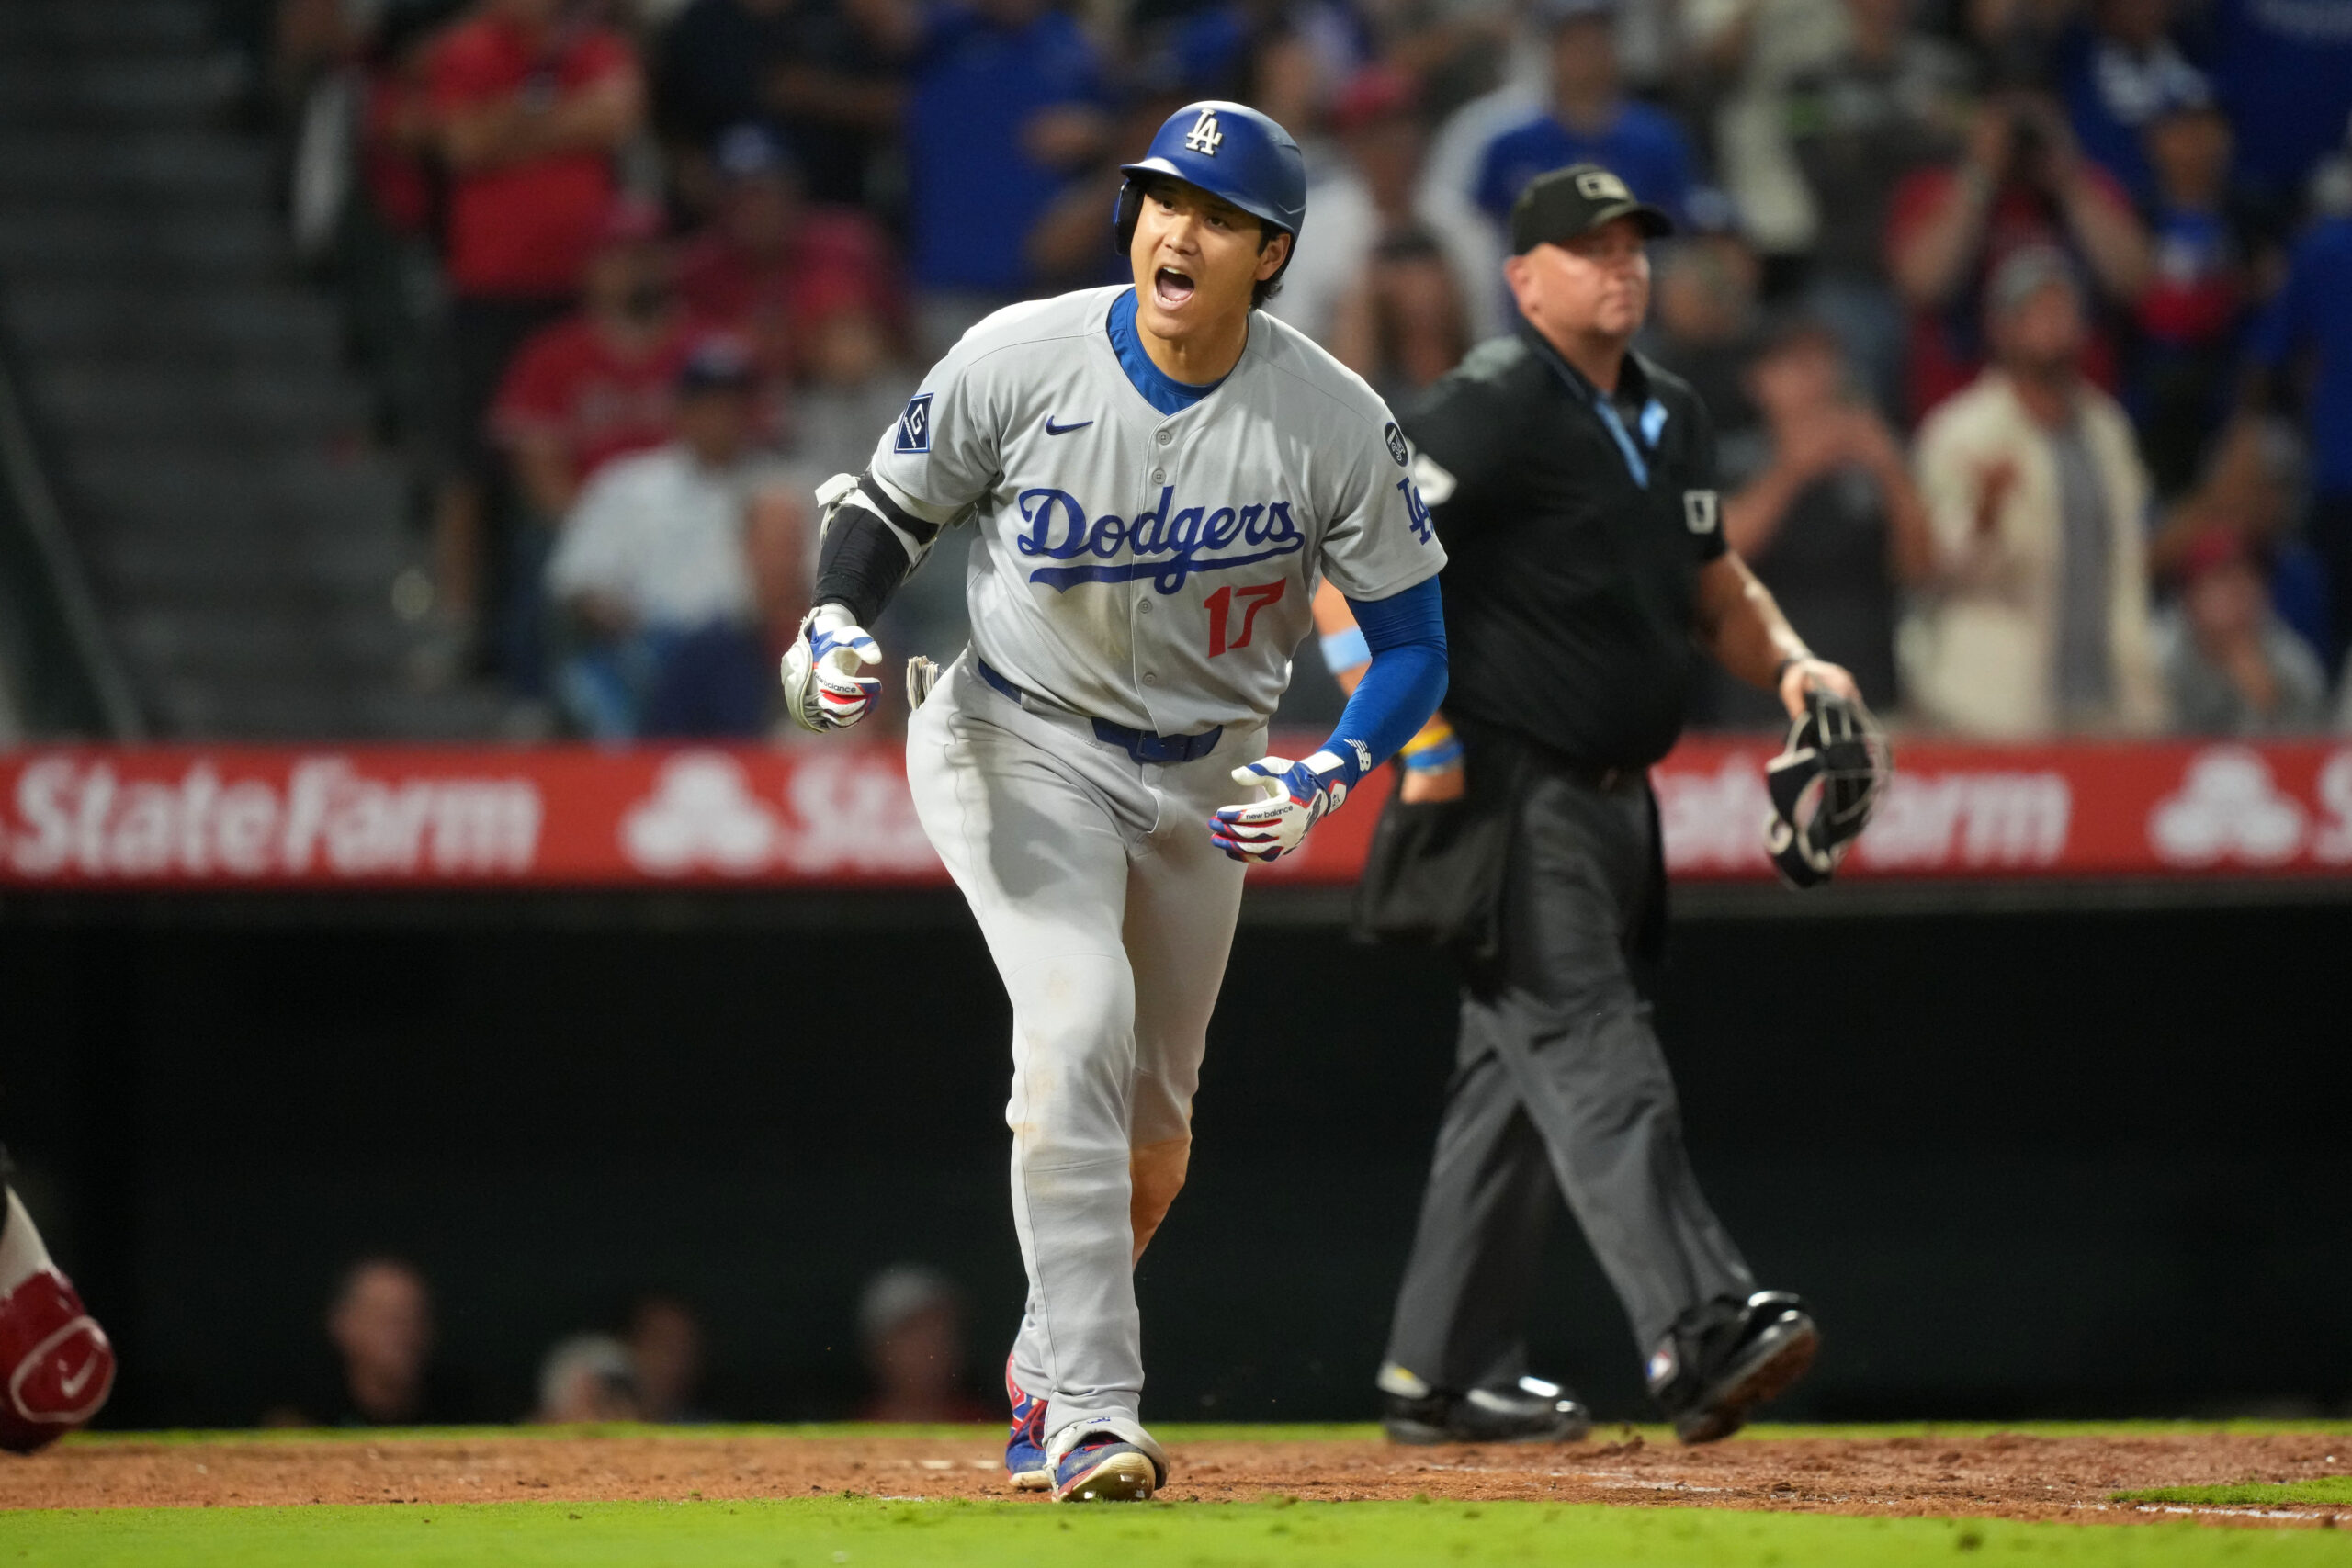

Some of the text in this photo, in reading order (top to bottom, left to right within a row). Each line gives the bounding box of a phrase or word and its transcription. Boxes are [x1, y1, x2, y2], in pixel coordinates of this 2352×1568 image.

[1185, 108, 1223, 155] LA
[1016, 484, 1305, 595] Dodgers
[1396, 477, 1434, 546] LA
[1204, 577, 1287, 659] 17
[1264, 805, 1294, 818] balance
